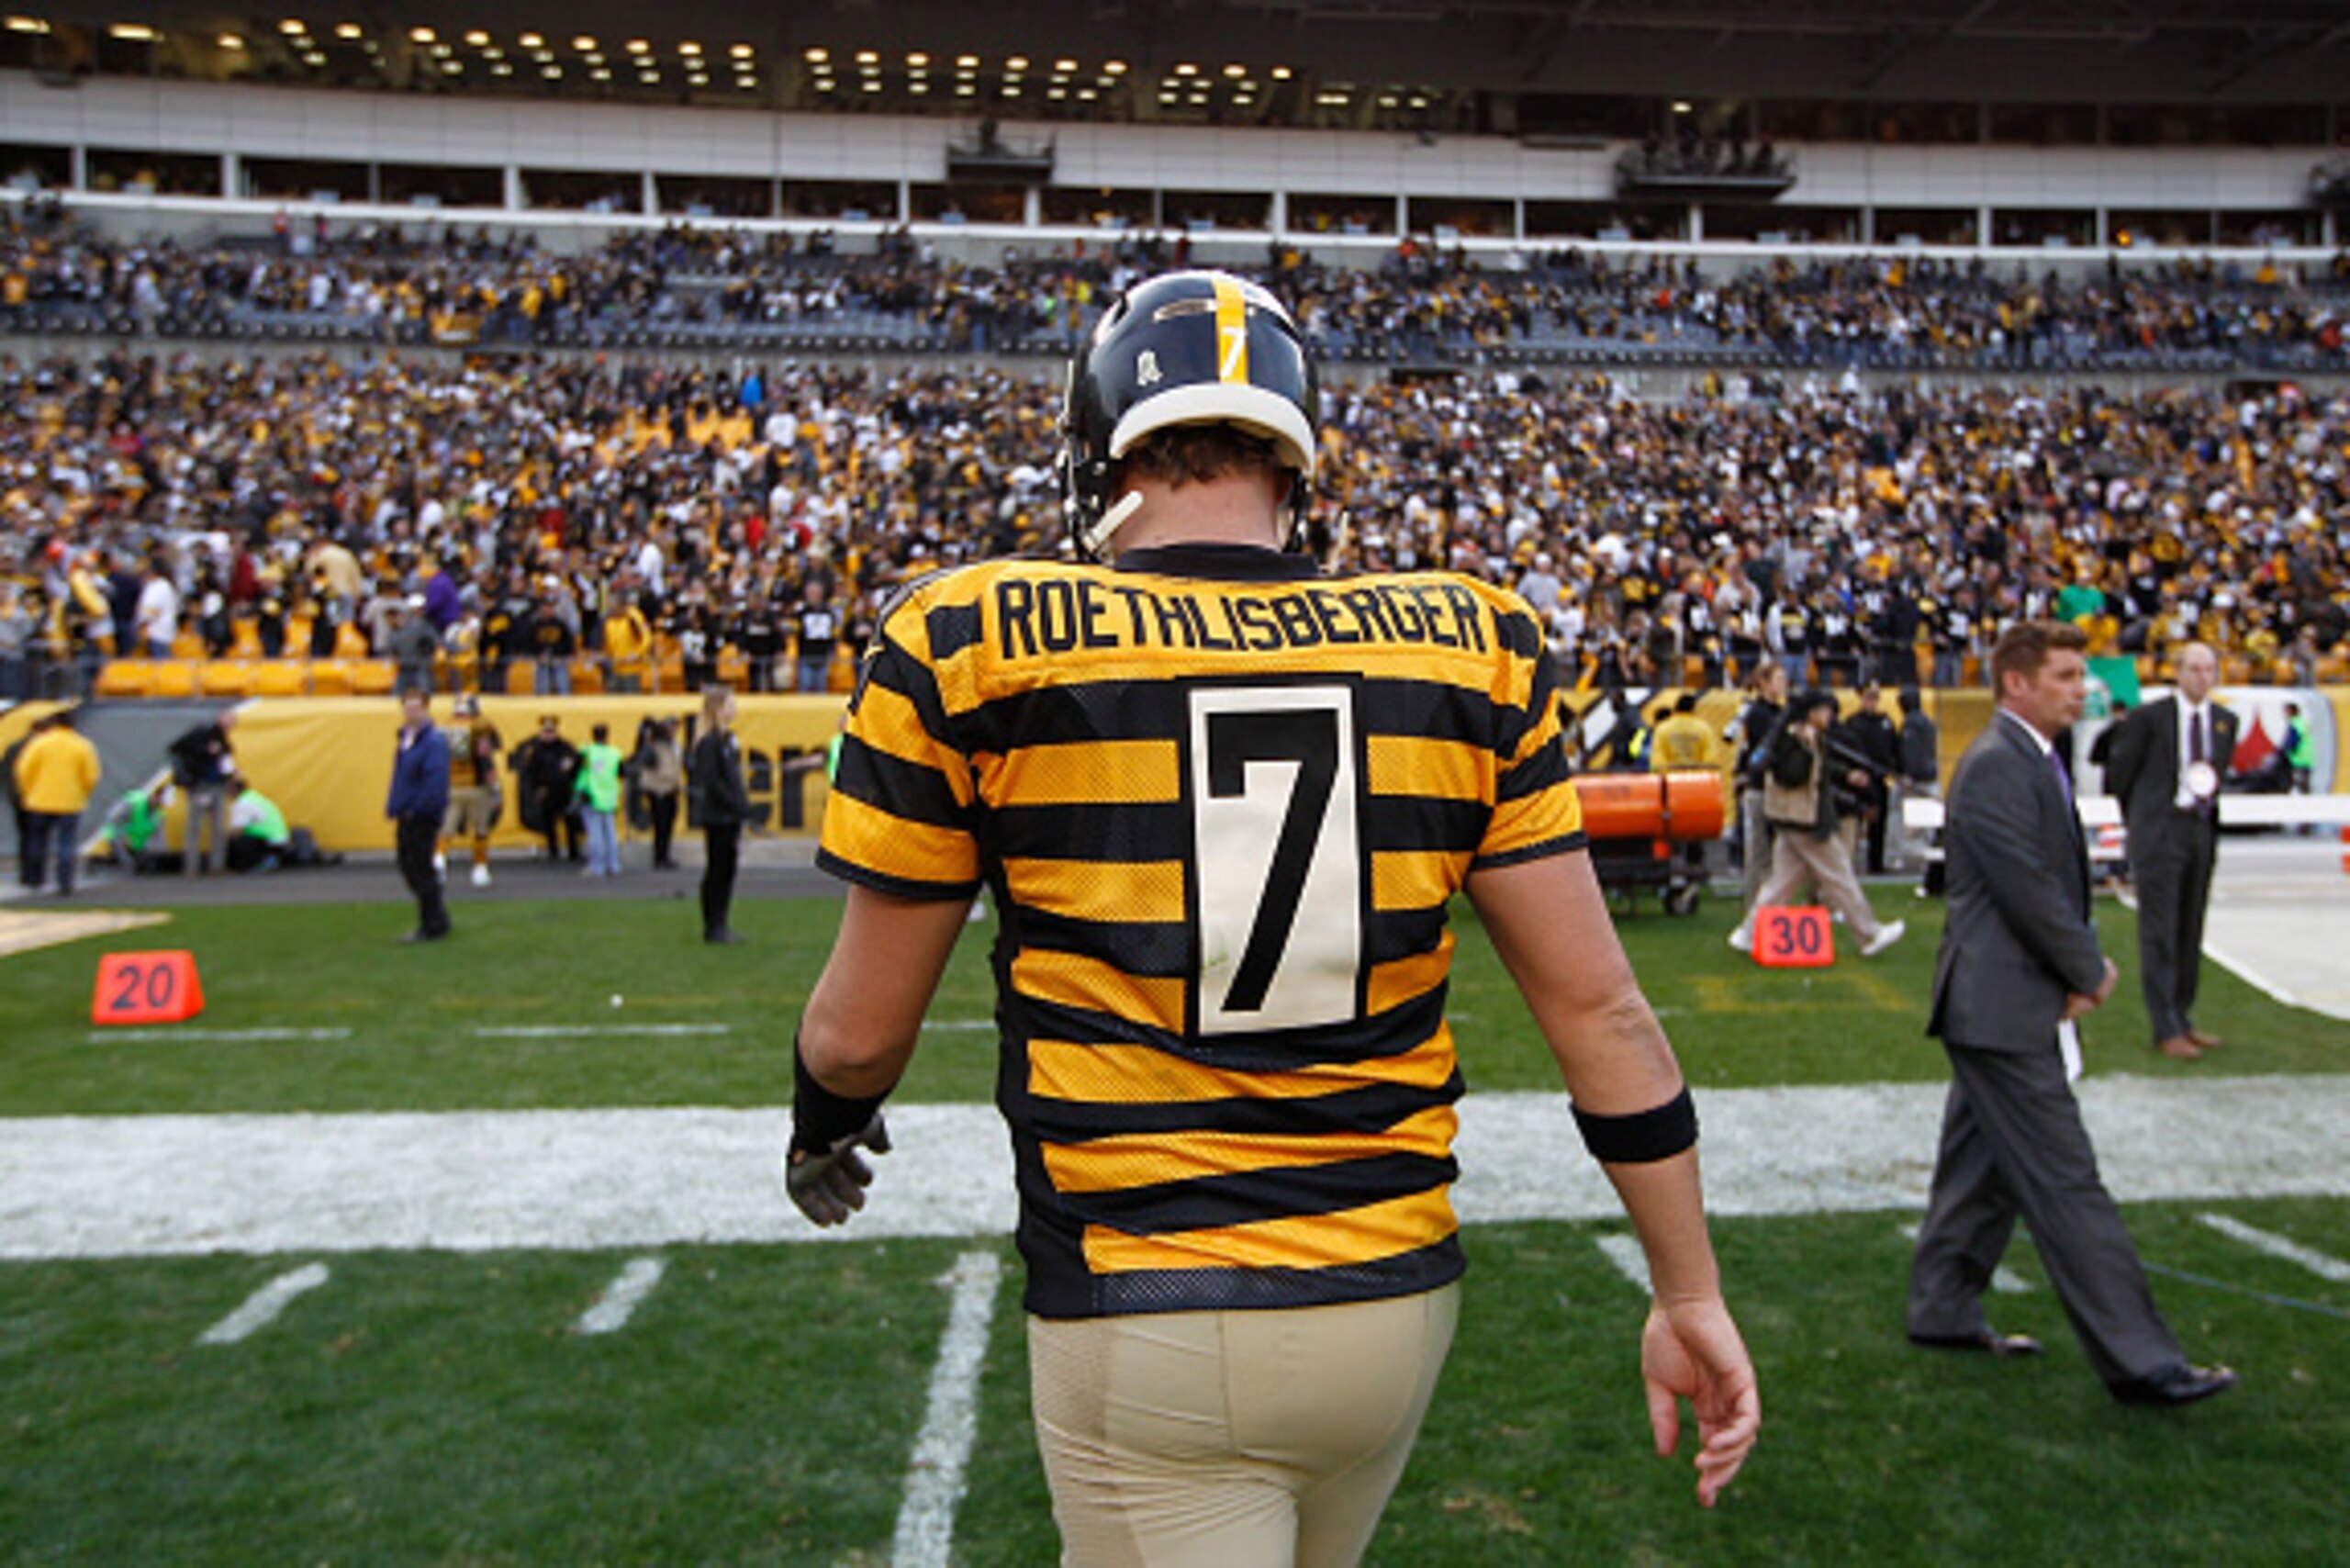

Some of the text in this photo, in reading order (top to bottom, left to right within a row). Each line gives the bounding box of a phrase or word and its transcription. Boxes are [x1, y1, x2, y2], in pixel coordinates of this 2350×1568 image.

[1219, 326, 1248, 378] 7
[997, 579, 1486, 656] ROETHLISBERGER
[1206, 708, 1340, 1013] 7
[1772, 916, 1821, 955] 30
[111, 964, 173, 1009] 20
